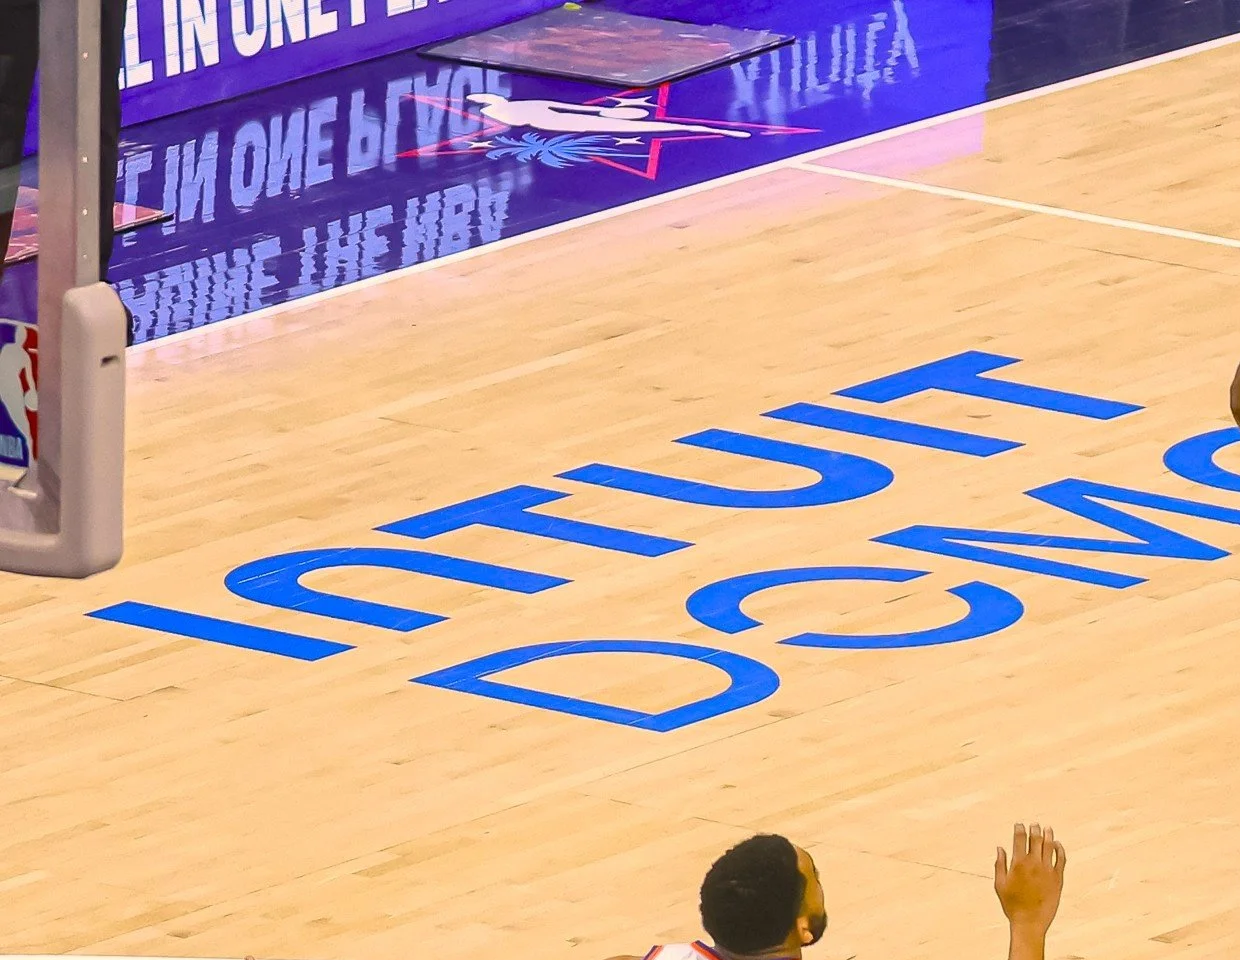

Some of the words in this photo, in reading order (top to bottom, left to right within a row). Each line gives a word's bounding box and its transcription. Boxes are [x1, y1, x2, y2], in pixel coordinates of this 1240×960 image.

[118, 0, 153, 90] L
[161, 0, 220, 77] IN
[87, 350, 1146, 661] INTUIT
